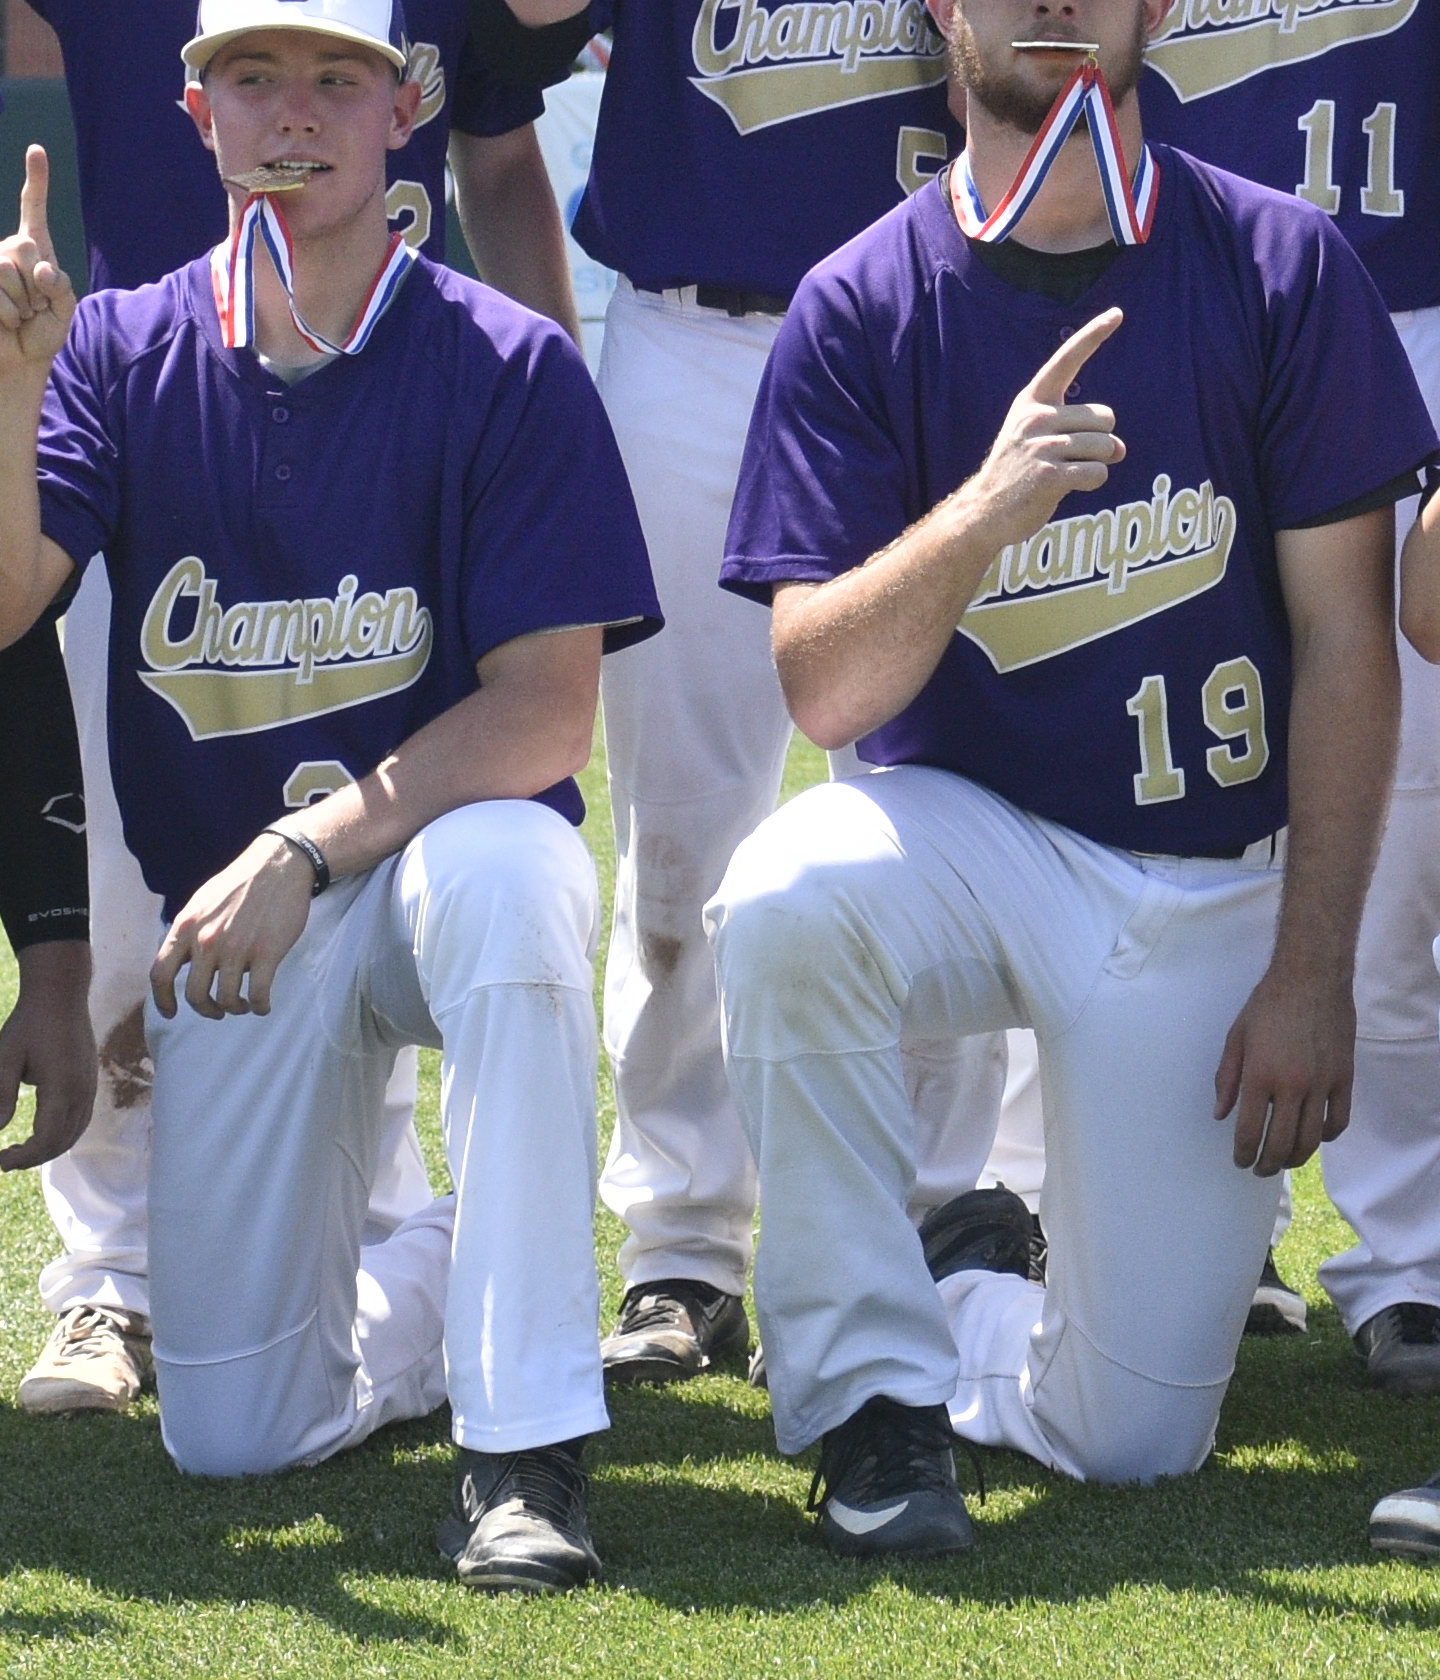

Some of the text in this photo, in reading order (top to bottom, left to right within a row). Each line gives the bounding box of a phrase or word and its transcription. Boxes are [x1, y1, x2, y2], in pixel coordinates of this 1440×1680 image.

[1295, 99, 1404, 218] 11
[970, 473, 1237, 607] hampion
[140, 555, 433, 685] Champion
[1126, 655, 1269, 806] 19
